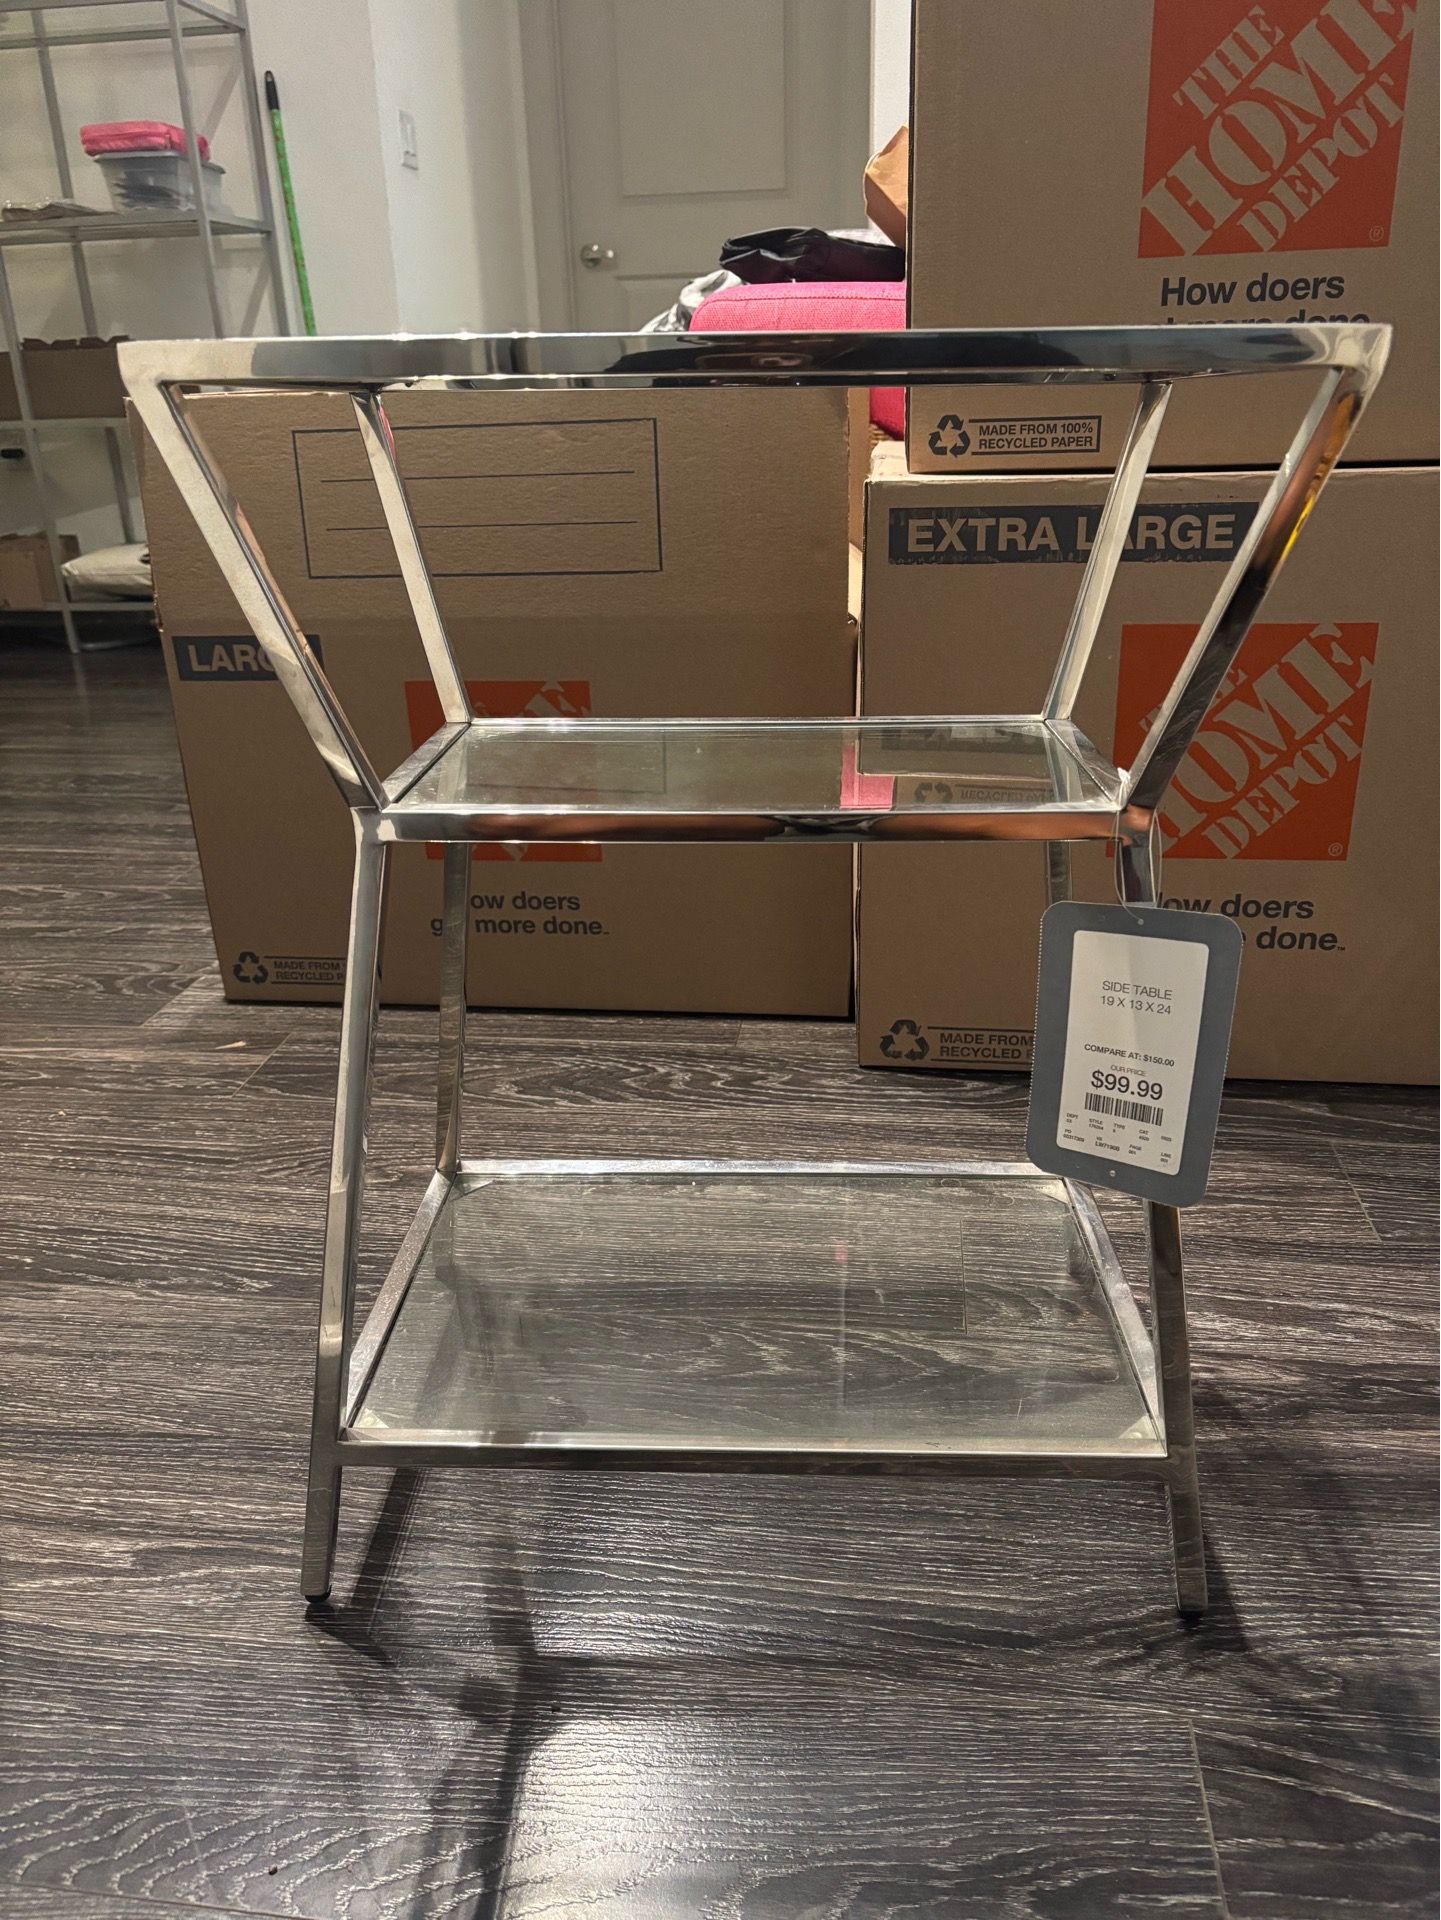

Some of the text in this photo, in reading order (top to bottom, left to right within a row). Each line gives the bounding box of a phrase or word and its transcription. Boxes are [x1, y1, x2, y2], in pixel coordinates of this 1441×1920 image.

[1172, 4, 1285, 120] THE
[1141, 0, 1414, 257] HOME
[1237, 72, 1405, 251] DEPOT
[1160, 272, 1345, 306] How doers
[979, 421, 1093, 436] MADE FROM 100%
[979, 436, 1093, 449] RECYCLED PAPER
[907, 513, 1237, 552] EXTRA LRGE
[1202, 714, 1364, 858] DEPOT
[470, 891, 581, 910] ow doers
[1157, 892, 1315, 919] ow doers
[475, 919, 536, 934] more
[274, 961, 341, 970] MADE FROM
[276, 971, 334, 981] RECYCLED
[1102, 980, 1173, 1000] SIDE TABLE
[1101, 995, 1171, 1015] 19 X 13 X 24
[940, 1033, 1034, 1046] MADE FROM
[940, 1046, 1022, 1059] RECYCLED
[1084, 1044, 1175, 1067] COMPARE AT: $150.00
[1110, 1064, 1147, 1077] OUR PRICE
[1091, 1069, 1163, 1100] $99.99
